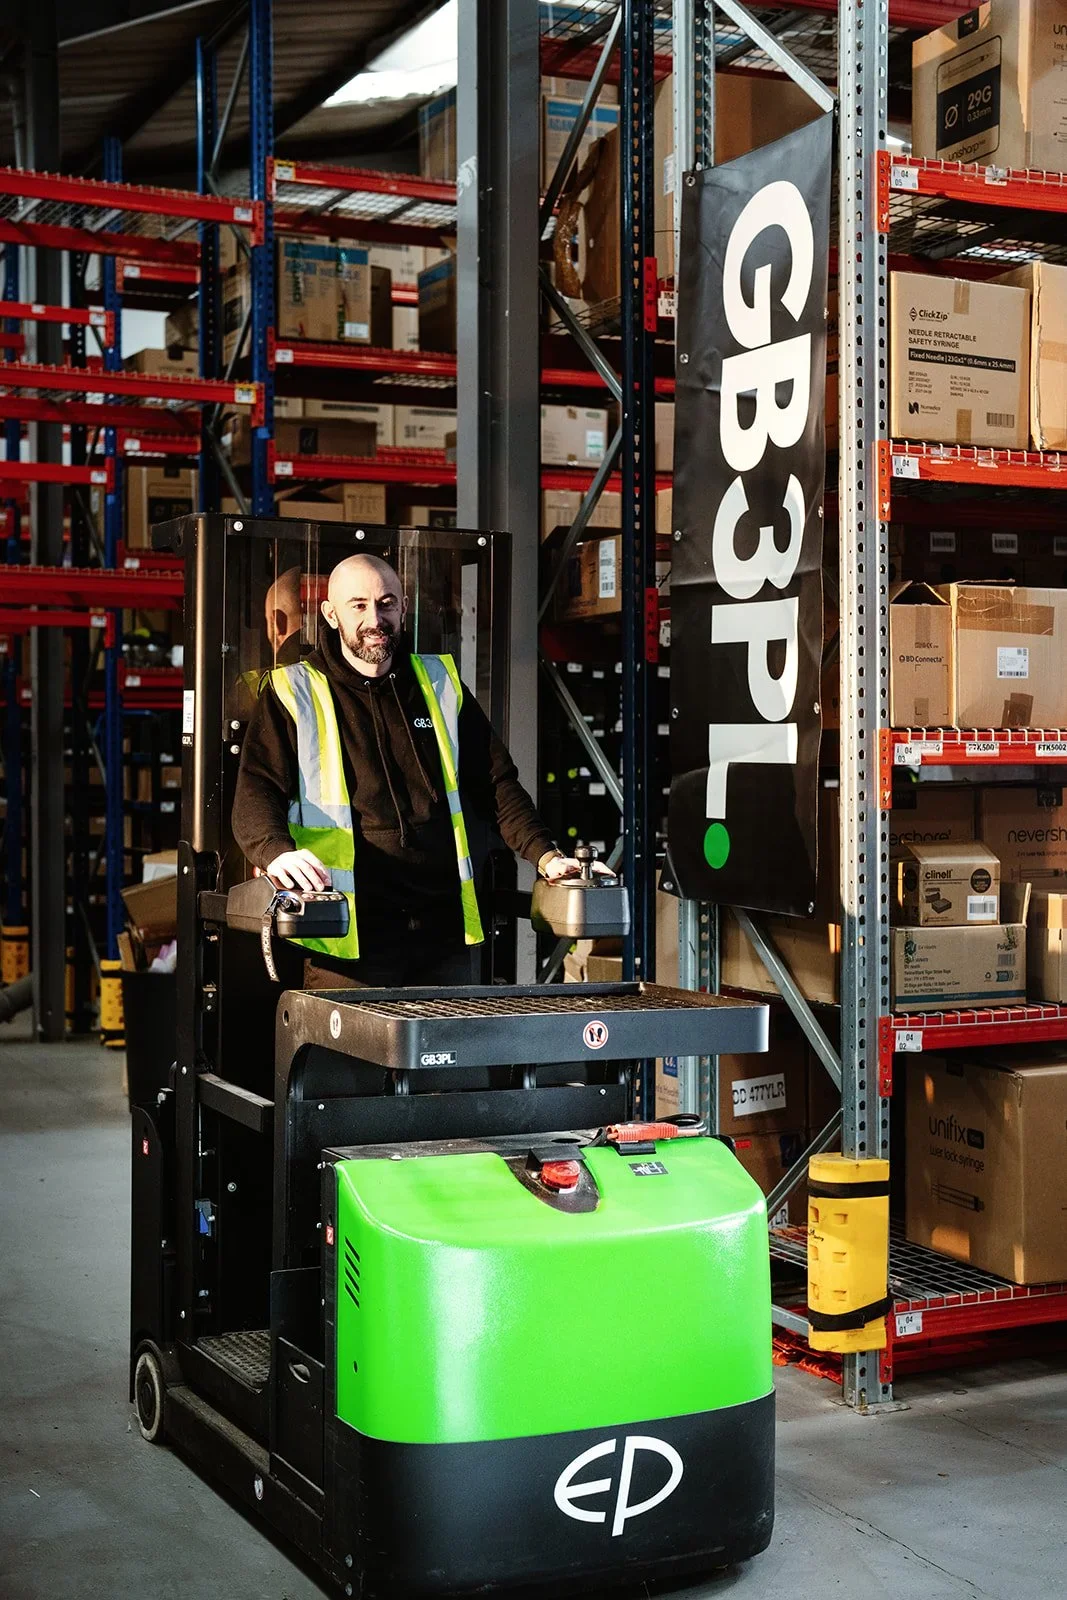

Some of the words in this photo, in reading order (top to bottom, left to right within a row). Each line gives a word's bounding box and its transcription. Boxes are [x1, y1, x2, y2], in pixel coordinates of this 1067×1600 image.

[968, 85, 992, 111] 29G
[967, 106, 992, 122] 0.33mm
[919, 309, 948, 321] ClickZip
[908, 328, 932, 337] NEEDLE
[934, 331, 976, 342] RETRACTABLE
[908, 338, 932, 346] SAFETY
[933, 340, 960, 348] SYRINGE
[910, 351, 925, 359] Fixed
[926, 352, 944, 361] Needle
[924, 870, 953, 880] clinell
[262, 926, 271, 952] PICKER
[264, 955, 276, 979] ORDER
[928, 1114, 967, 1144] unifix
[958, 1154, 984, 1172] syringe
[554, 1436, 684, 1537] EP
